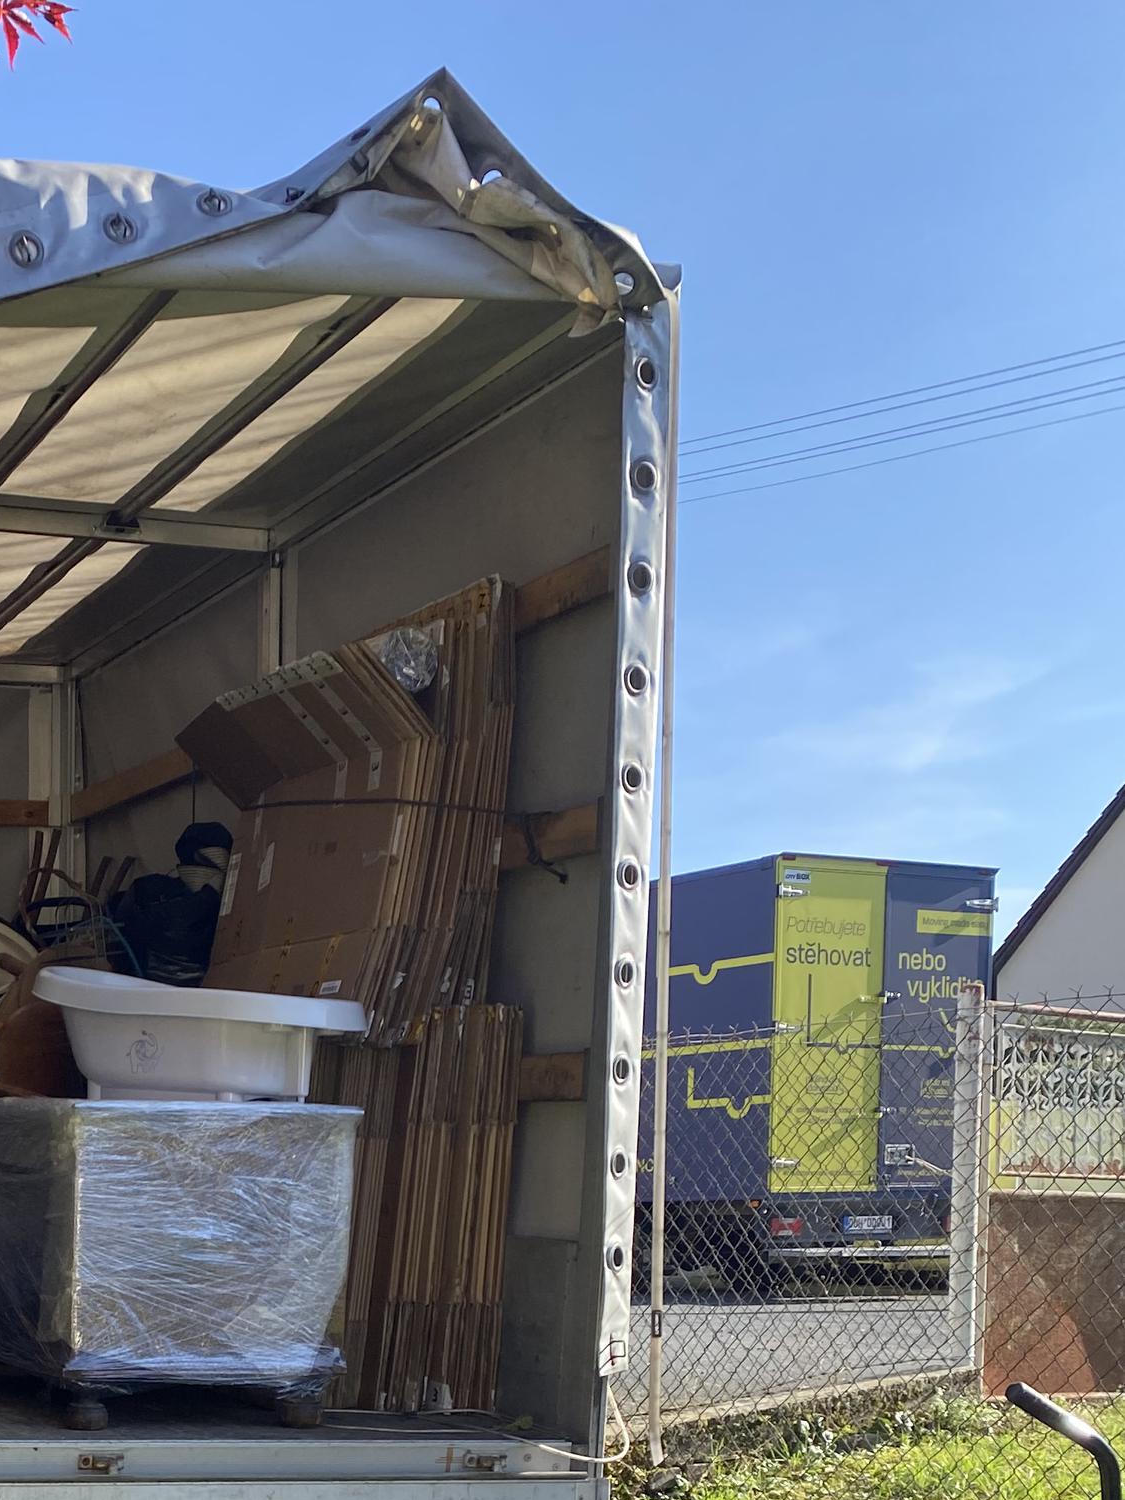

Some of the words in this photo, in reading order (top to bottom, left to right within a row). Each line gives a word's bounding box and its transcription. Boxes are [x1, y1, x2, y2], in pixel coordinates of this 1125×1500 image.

[786, 916, 867, 939] Potřebujete
[786, 942, 872, 968] stěhovat
[898, 947, 947, 971] nebo
[907, 975, 984, 1003] vyklid
